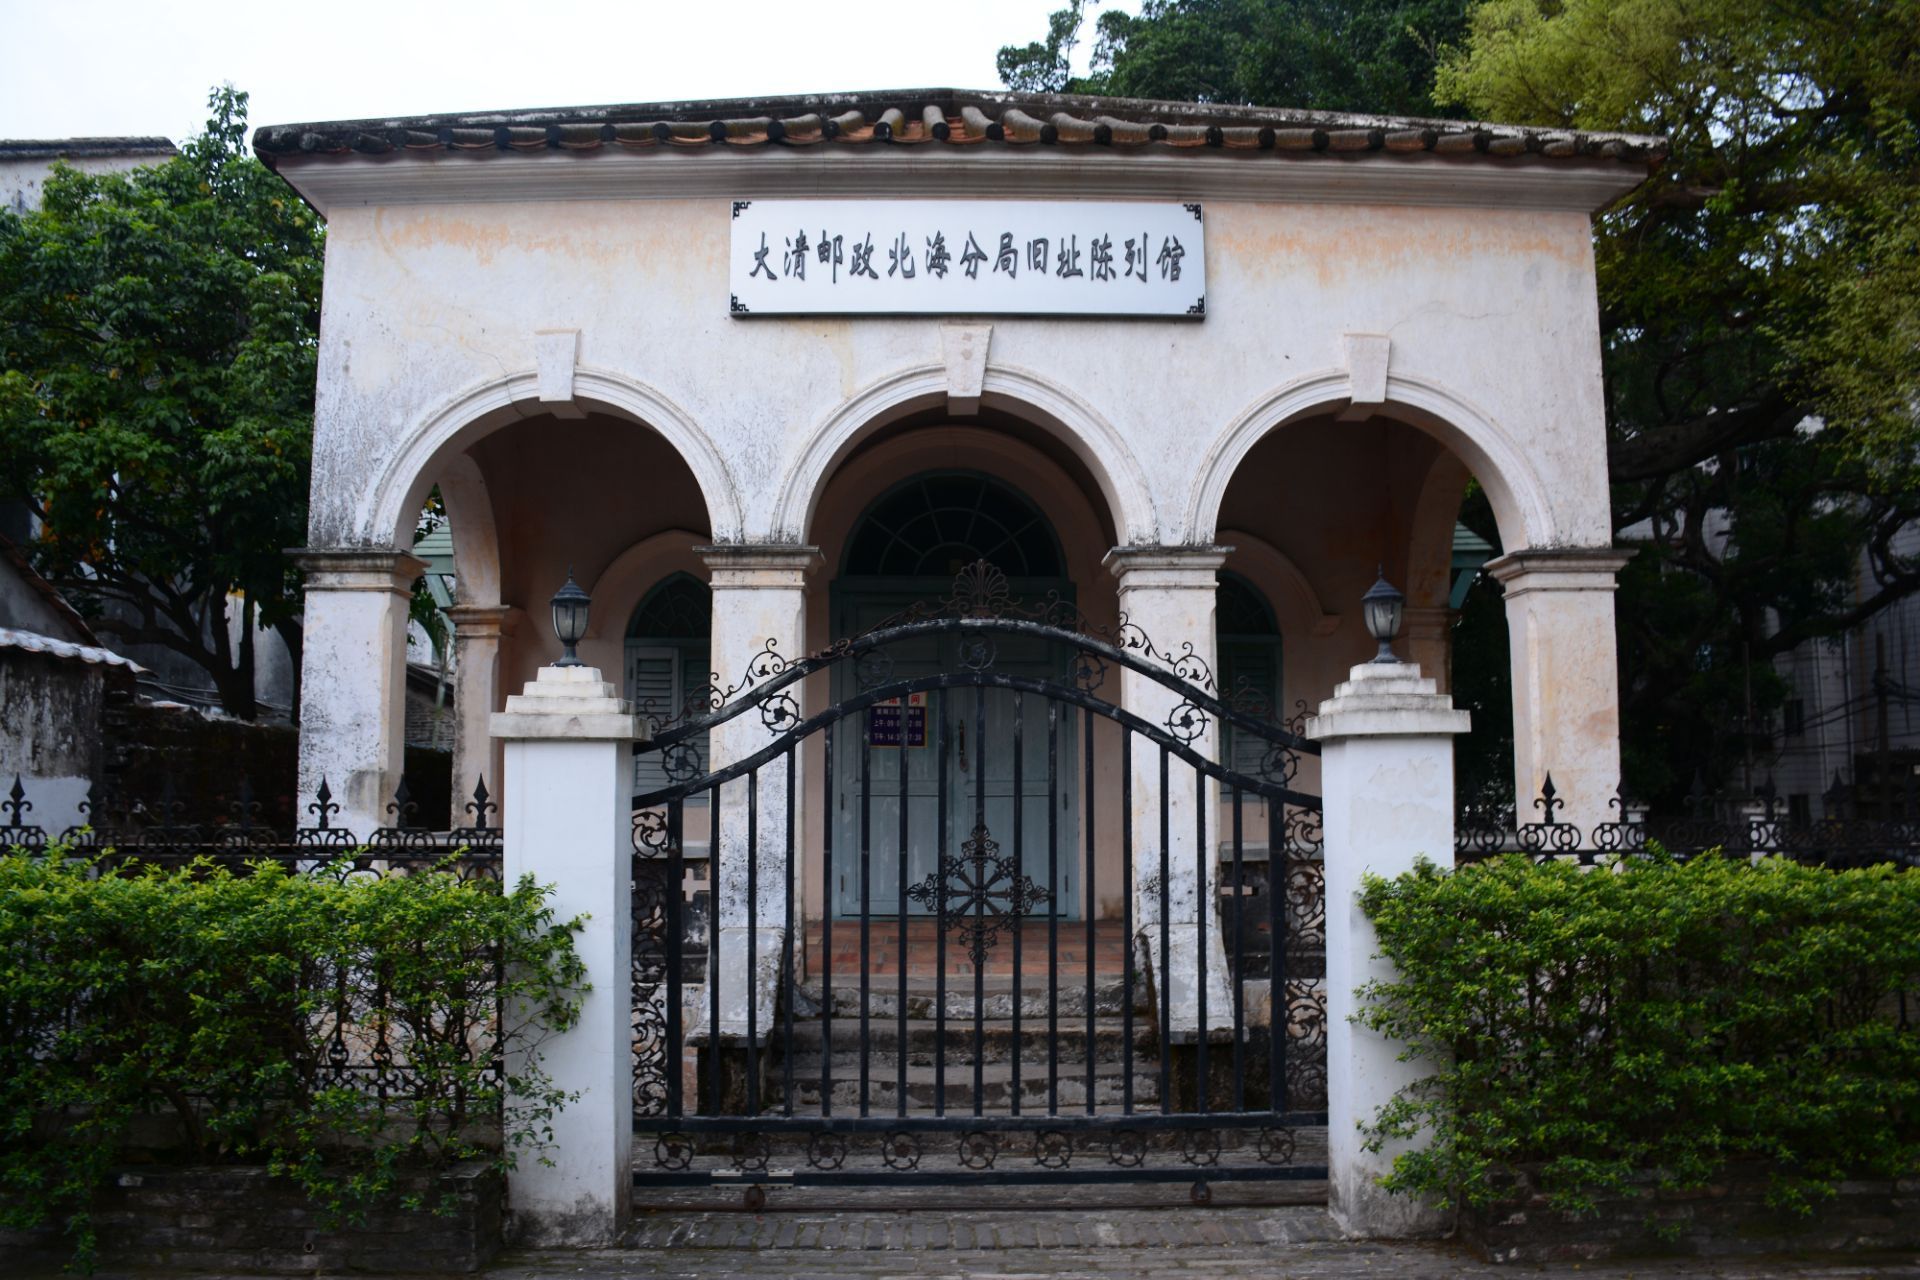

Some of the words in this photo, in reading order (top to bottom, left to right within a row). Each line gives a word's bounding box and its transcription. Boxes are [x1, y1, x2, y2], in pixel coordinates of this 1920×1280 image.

[749, 229, 1187, 285] 大清邮政北海分局旧址陈列馆
